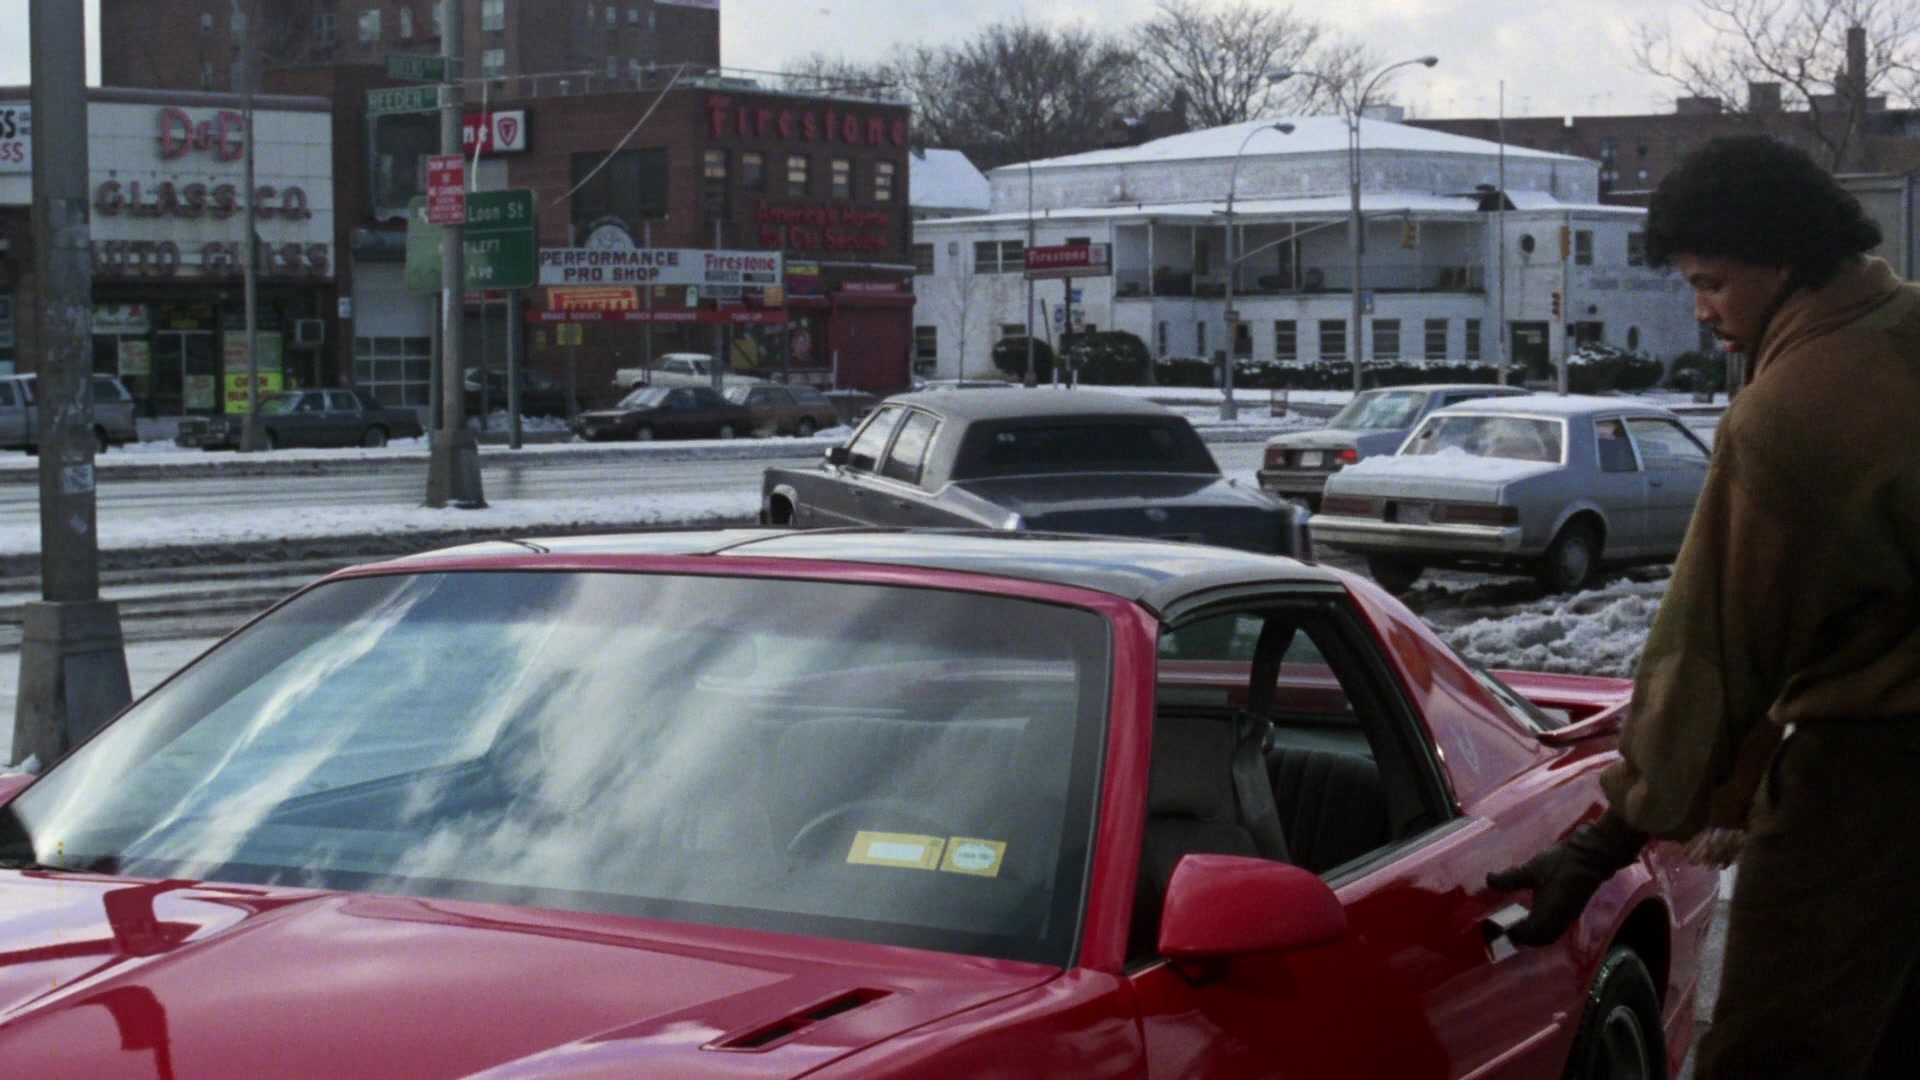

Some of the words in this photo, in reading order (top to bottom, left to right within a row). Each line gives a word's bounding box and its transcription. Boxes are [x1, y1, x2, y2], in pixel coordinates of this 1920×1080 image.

[704, 95, 907, 146] Firestone
[97, 181, 237, 219] GLASS
[468, 206, 501, 223] Loon
[507, 201, 524, 219] St
[540, 251, 679, 266] PERFORMANCE
[704, 253, 775, 271] Firestone
[1029, 250, 1087, 265] Firestone
[468, 265, 493, 279] Ave
[564, 267, 603, 281] PRO
[613, 267, 660, 281] SHOP
